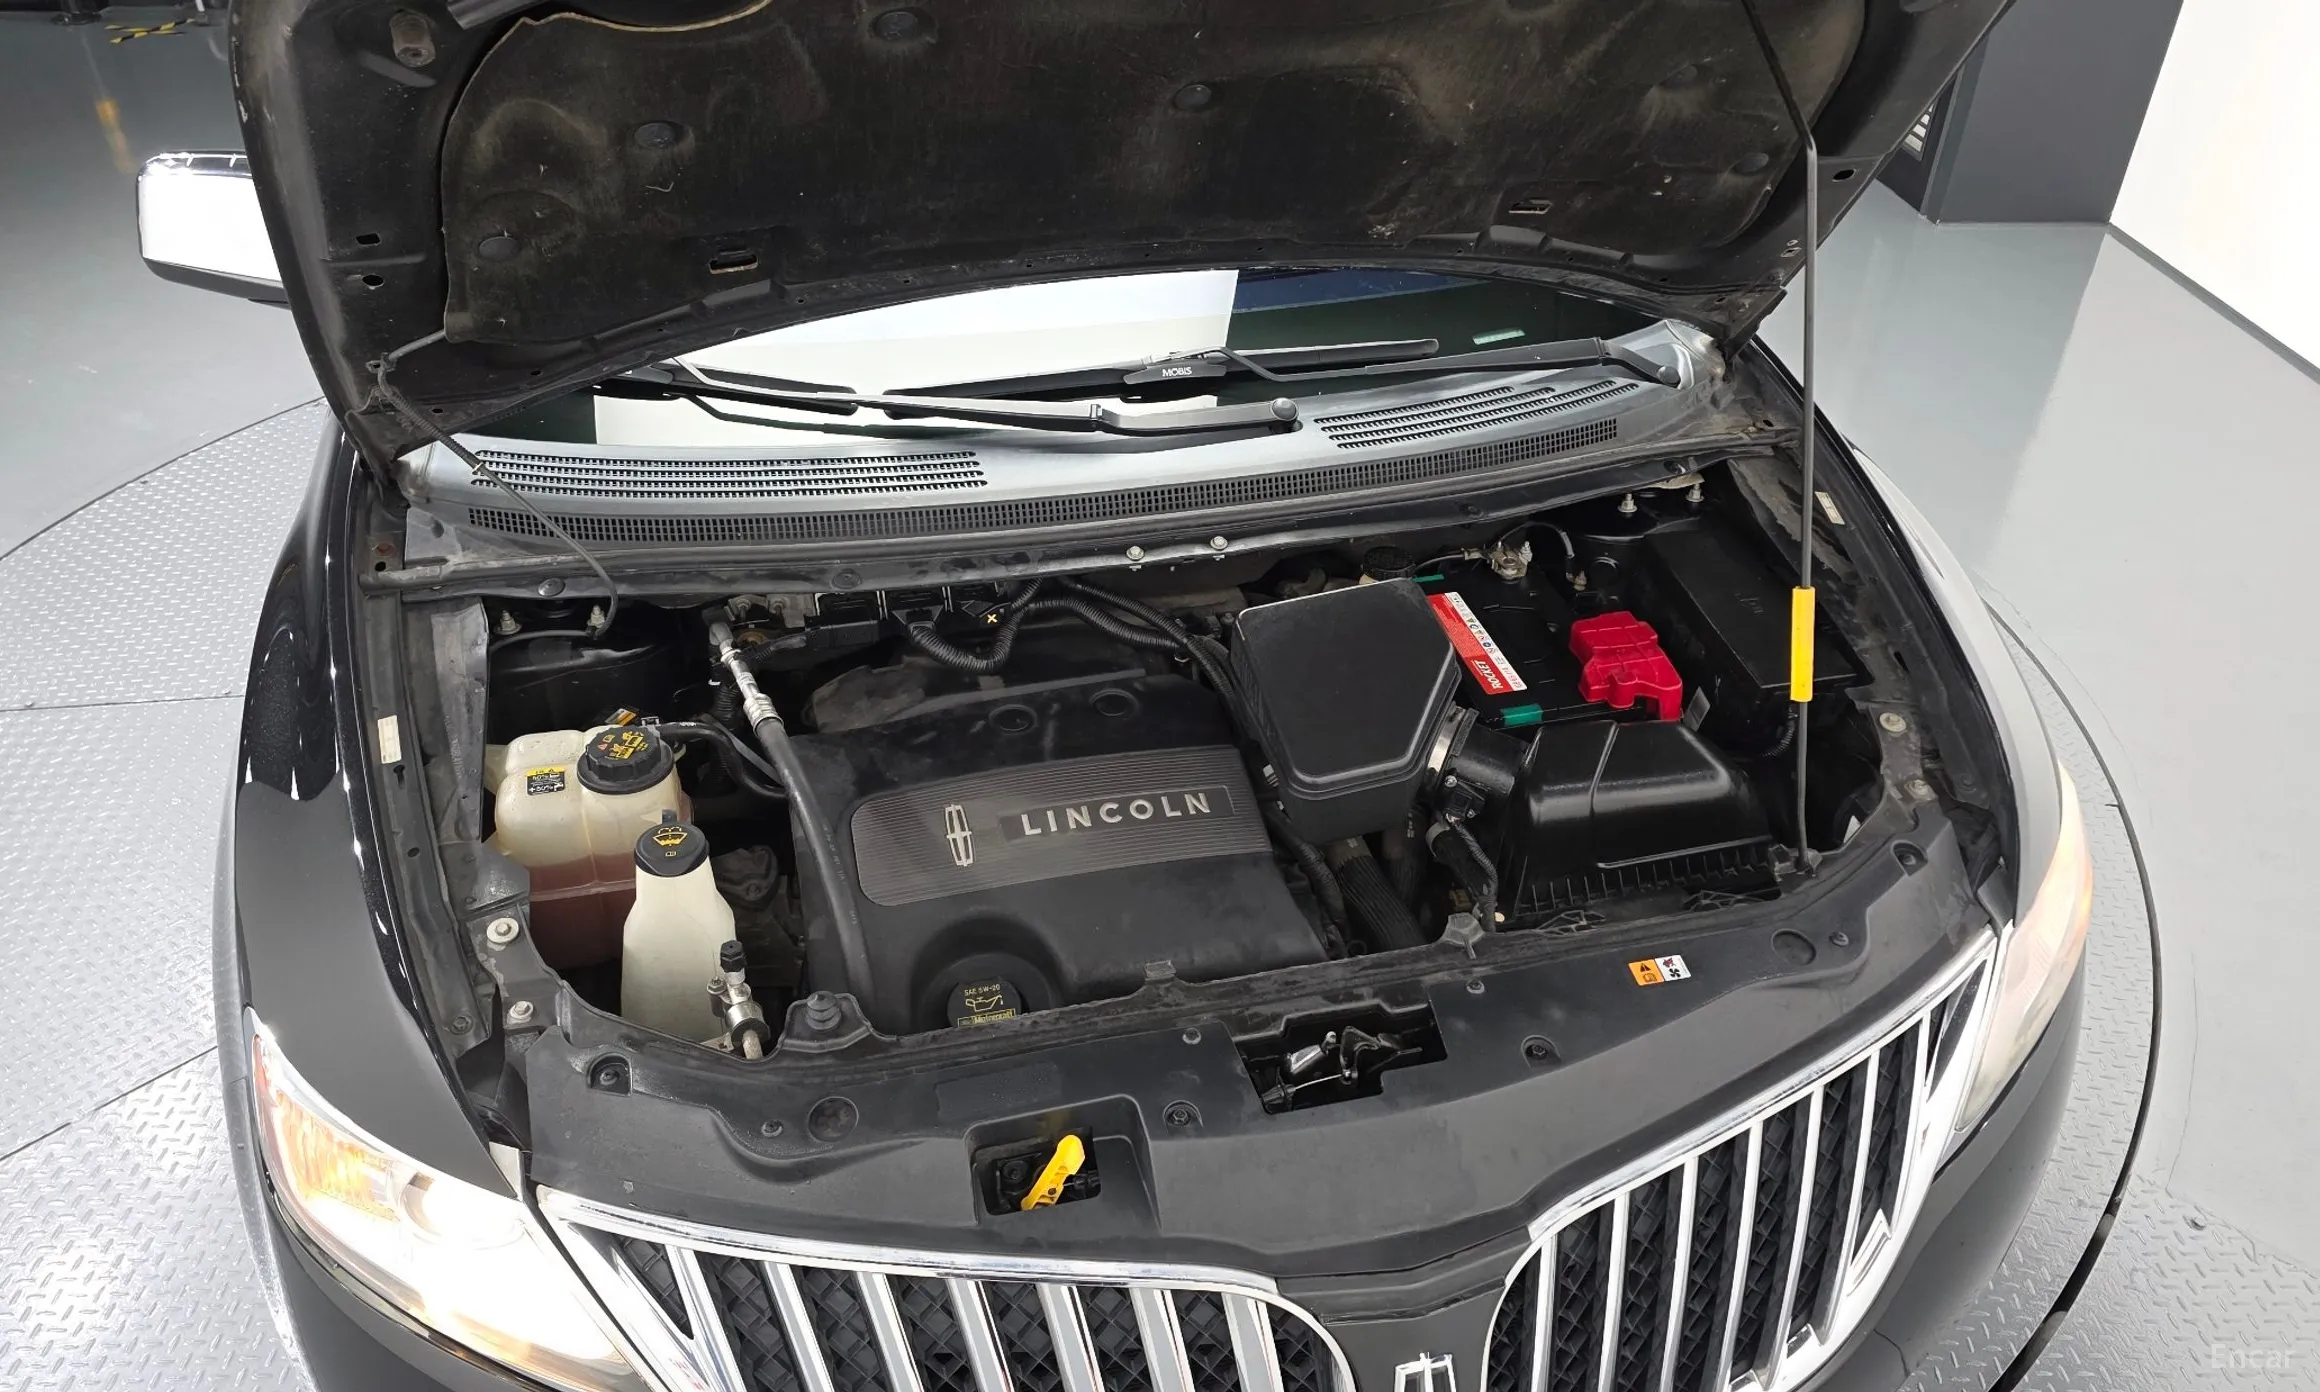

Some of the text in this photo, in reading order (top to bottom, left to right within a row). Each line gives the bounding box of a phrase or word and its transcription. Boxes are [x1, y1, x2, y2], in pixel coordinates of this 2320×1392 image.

[1162, 366, 1192, 377] MOBIS
[1473, 659, 1504, 689] ROCKET
[1021, 792, 1211, 836] LINCOLN
